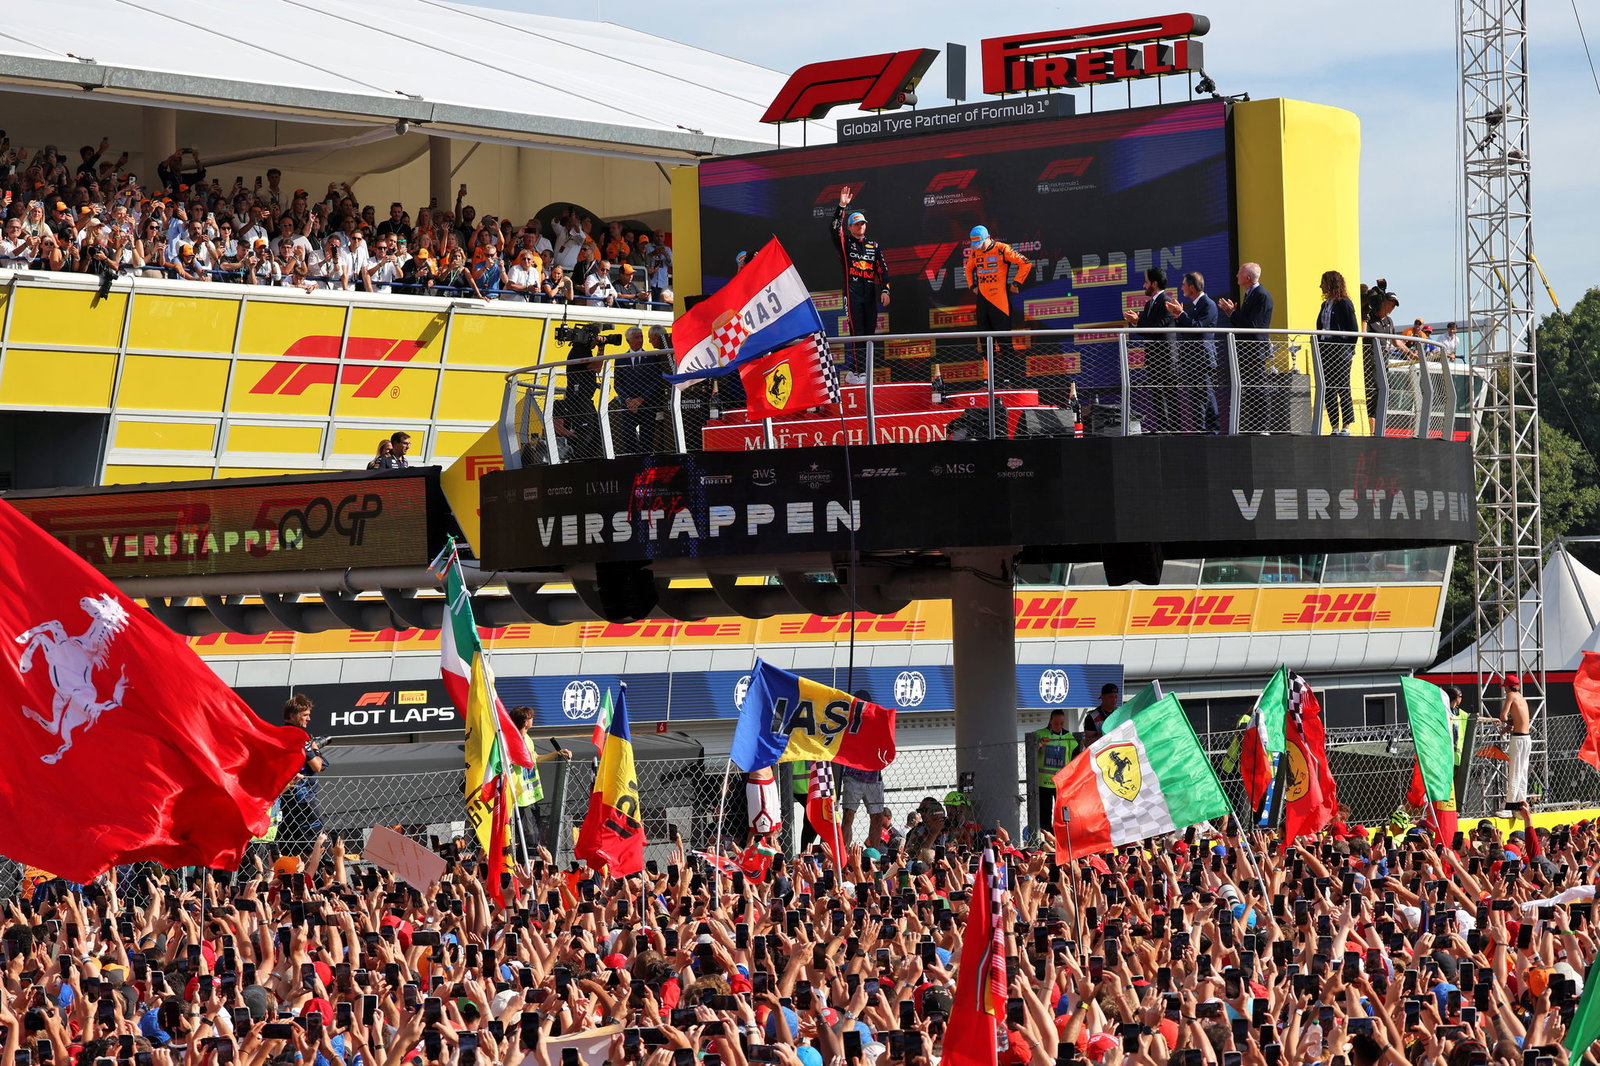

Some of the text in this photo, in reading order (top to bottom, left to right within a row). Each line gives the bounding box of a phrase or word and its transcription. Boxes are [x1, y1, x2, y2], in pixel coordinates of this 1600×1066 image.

[981, 13, 1205, 94] PIRELLI
[842, 118, 882, 136] Global
[884, 117, 912, 132] Tyre
[914, 111, 961, 128] Partner
[964, 108, 978, 122] of
[981, 102, 1034, 119] Formula
[849, 252, 876, 262] ORACLE
[1028, 300, 1074, 317] PIRELLI
[848, 393, 857, 408] 1
[969, 396, 975, 406] 3
[752, 468, 775, 479] aws
[946, 463, 975, 474] MSC
[996, 471, 1034, 479] salesforce
[547, 486, 573, 496] aramco
[586, 480, 619, 495] LVMH
[1231, 488, 1470, 523] VERSTAPPEN
[537, 500, 861, 548] VERSTAPPEN
[102, 529, 304, 558] VERSTAPPEN
[1148, 595, 1236, 627] DHL
[1297, 593, 1377, 624] DHL
[330, 706, 455, 727] HOT LAPS
